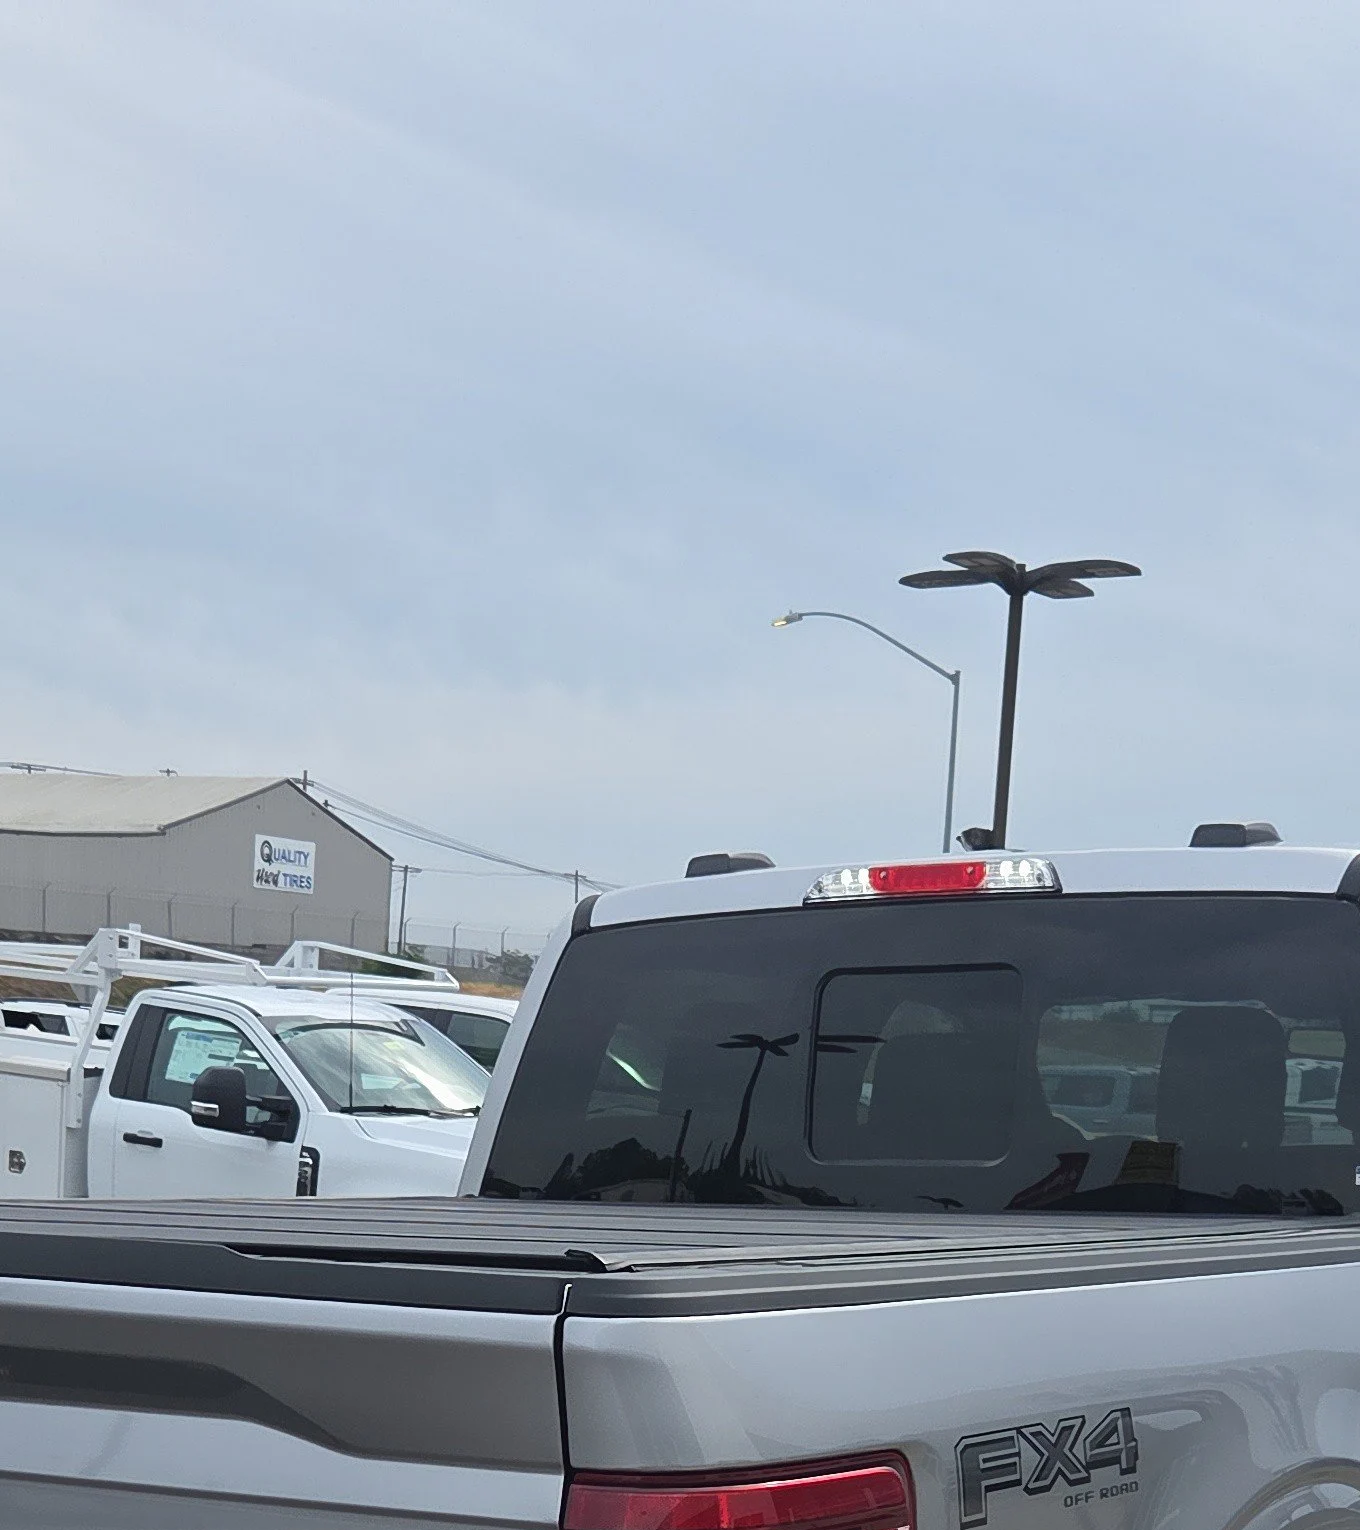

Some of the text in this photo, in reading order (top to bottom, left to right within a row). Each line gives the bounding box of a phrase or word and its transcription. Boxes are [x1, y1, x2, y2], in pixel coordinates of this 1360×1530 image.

[260, 840, 310, 867] QUALITY
[281, 872, 312, 890] TIRES
[953, 1406, 1139, 1530] FX4
[1063, 1480, 1139, 1509] OFF ROAD
